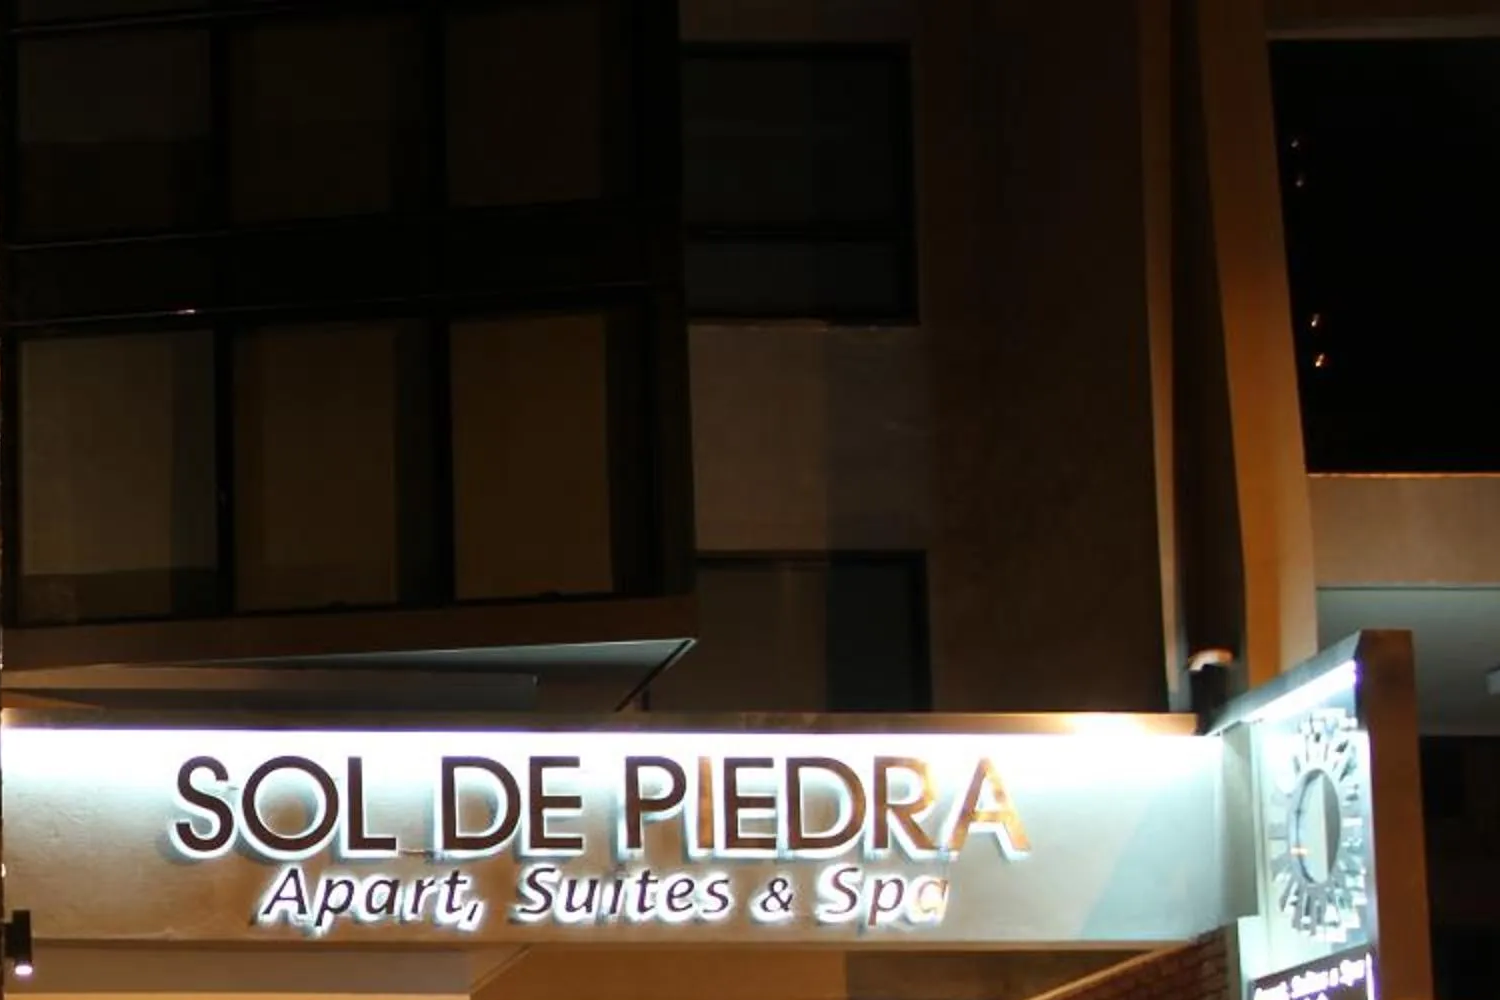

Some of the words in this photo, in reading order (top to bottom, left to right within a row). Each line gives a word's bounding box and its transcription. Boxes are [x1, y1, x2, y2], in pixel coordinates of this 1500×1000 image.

[175, 755, 397, 852] SOL
[441, 755, 583, 851] DE
[624, 755, 1031, 853] PIEDRA
[262, 867, 479, 928] Apart,
[519, 866, 731, 916] Suites
[760, 876, 794, 914] &
[824, 866, 949, 927] Spa
